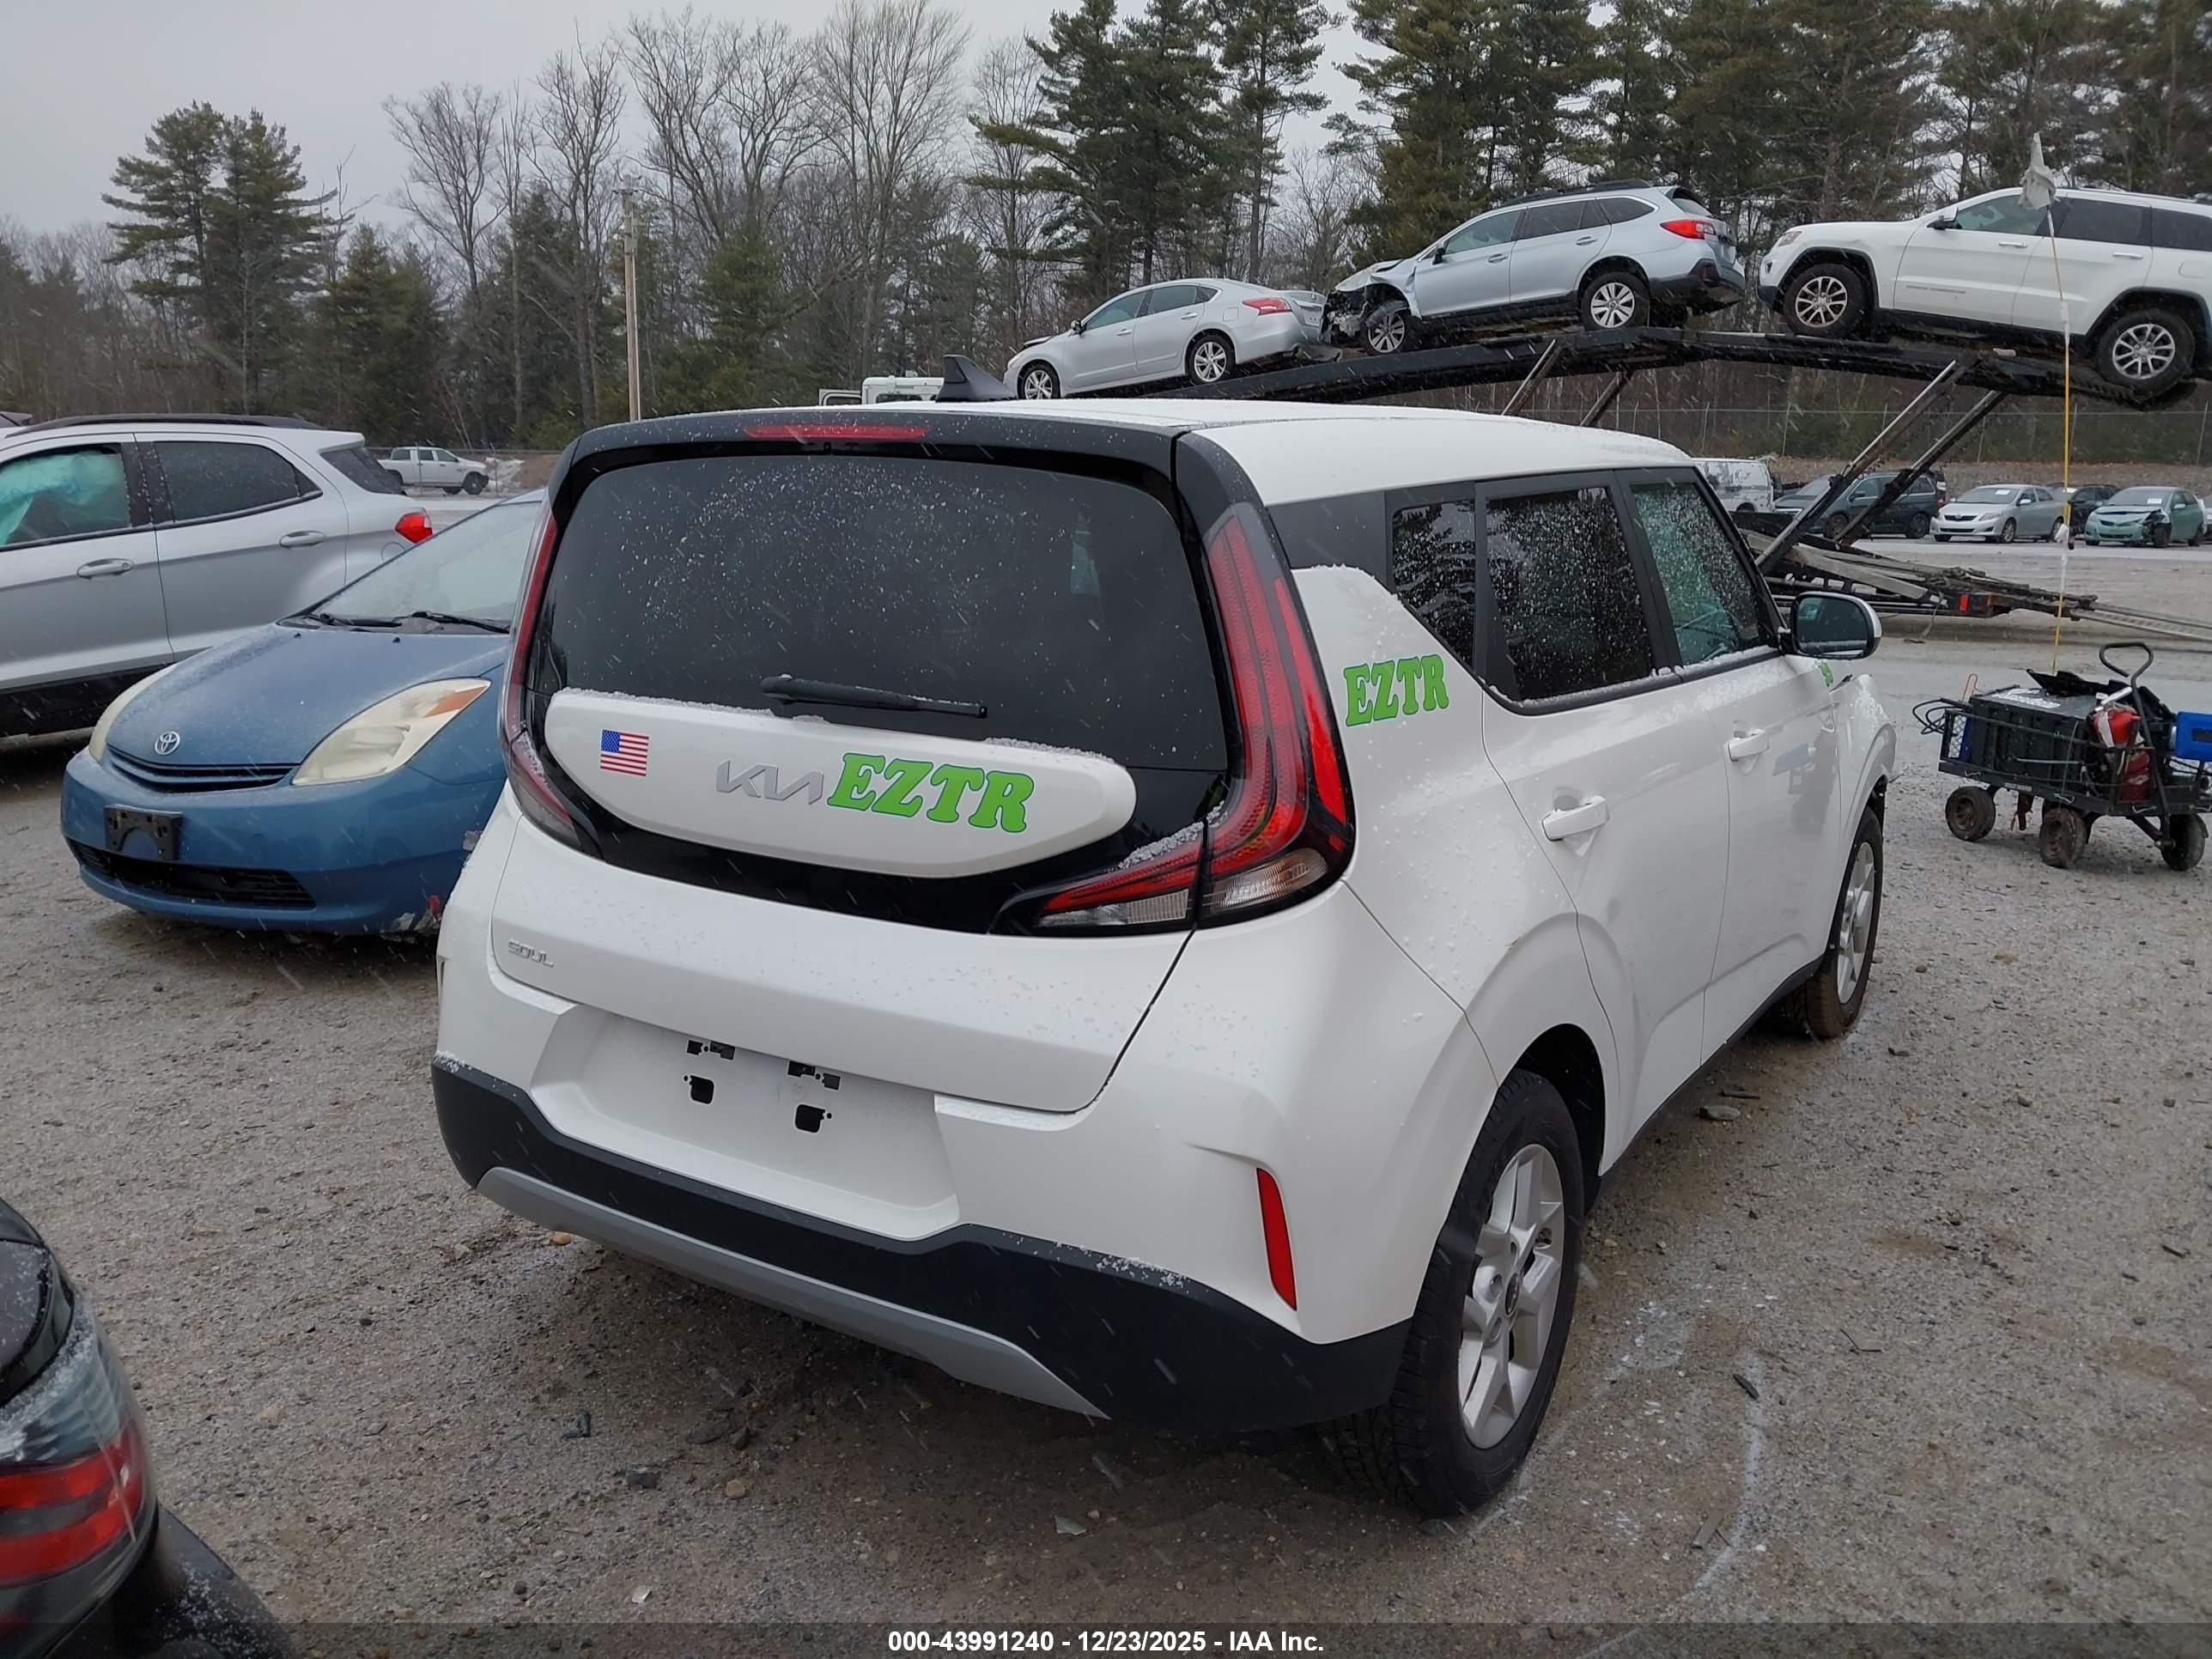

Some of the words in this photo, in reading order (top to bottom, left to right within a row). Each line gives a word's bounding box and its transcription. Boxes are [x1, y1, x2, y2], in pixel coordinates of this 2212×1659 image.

[1344, 653, 1449, 727] EZTR
[827, 752, 1035, 834] EZTR
[508, 939, 554, 968] SOUL
